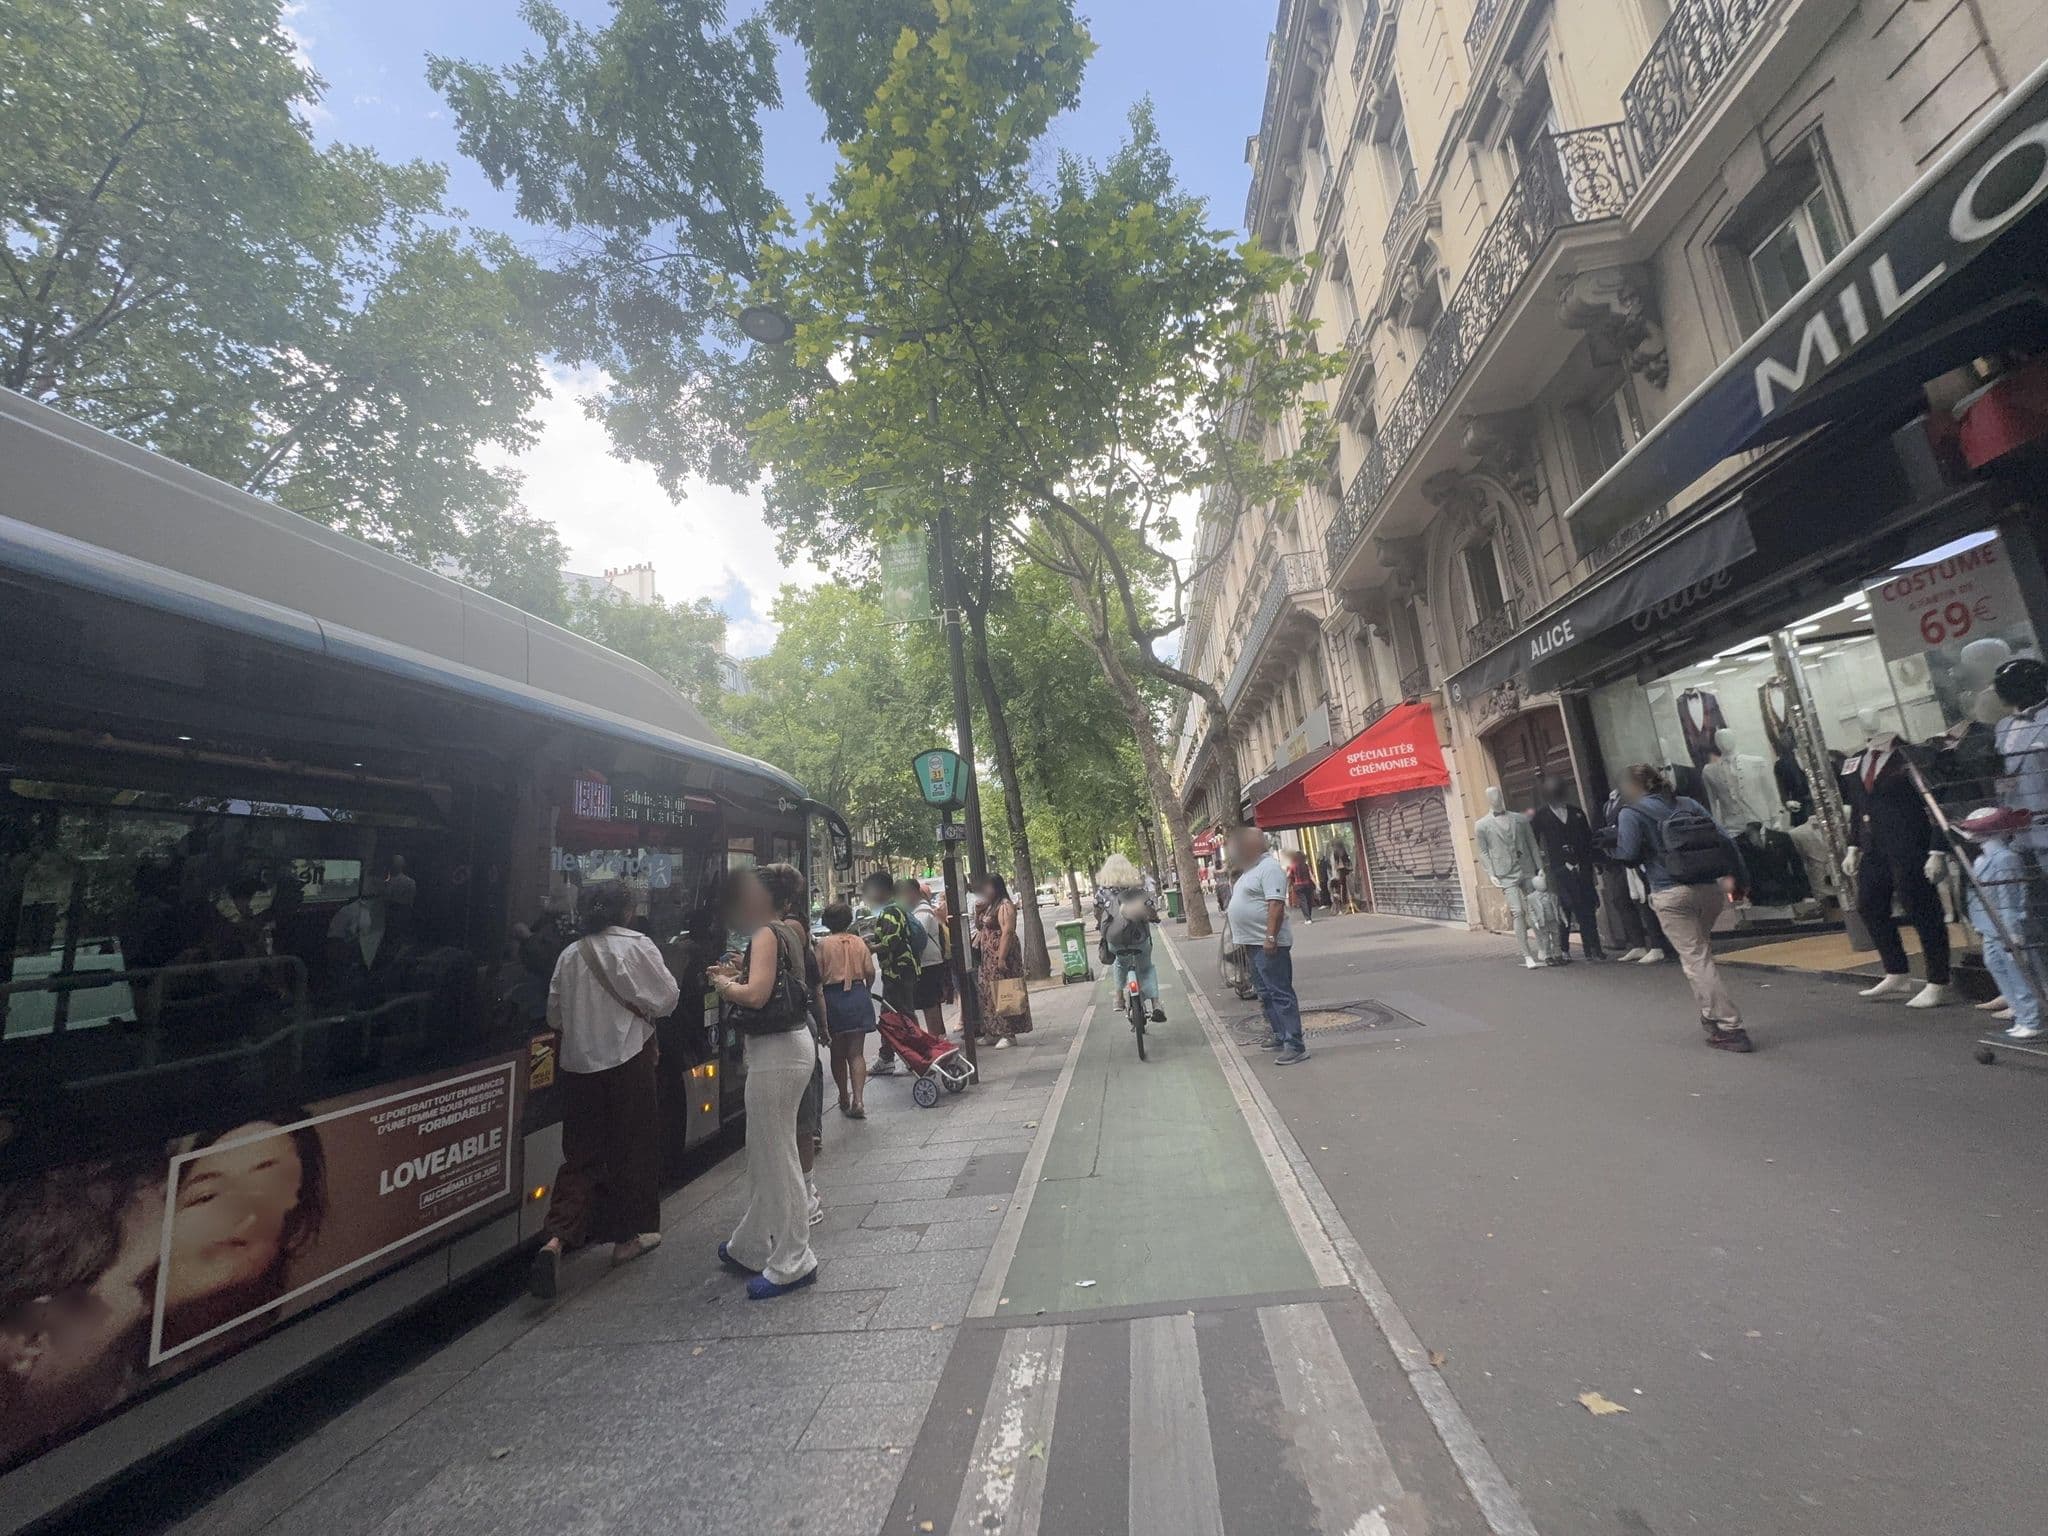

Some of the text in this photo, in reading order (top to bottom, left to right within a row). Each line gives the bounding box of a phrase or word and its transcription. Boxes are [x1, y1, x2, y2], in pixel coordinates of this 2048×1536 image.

[1754, 121, 2048, 418] MILO
[1882, 543, 1996, 602] COSTUME
[1531, 618, 1575, 660] ALICE
[1346, 743, 1415, 764] SPÉCIALITÉS
[1349, 756, 1418, 777] CÉRÉMONIES
[932, 770, 941, 780] 31
[933, 783, 943, 792] 54
[386, 1099, 434, 1121] PORTRAIT
[434, 1093, 456, 1105] TOUT
[455, 1089, 468, 1099] EN
[467, 1077, 505, 1096] NUANCES
[378, 1119, 406, 1135] D'UNE
[407, 1108, 439, 1127] FEMME
[439, 1101, 463, 1116] SOUS
[380, 1127, 503, 1196] LOVEABLE
[423, 1192, 435, 1204] AU
